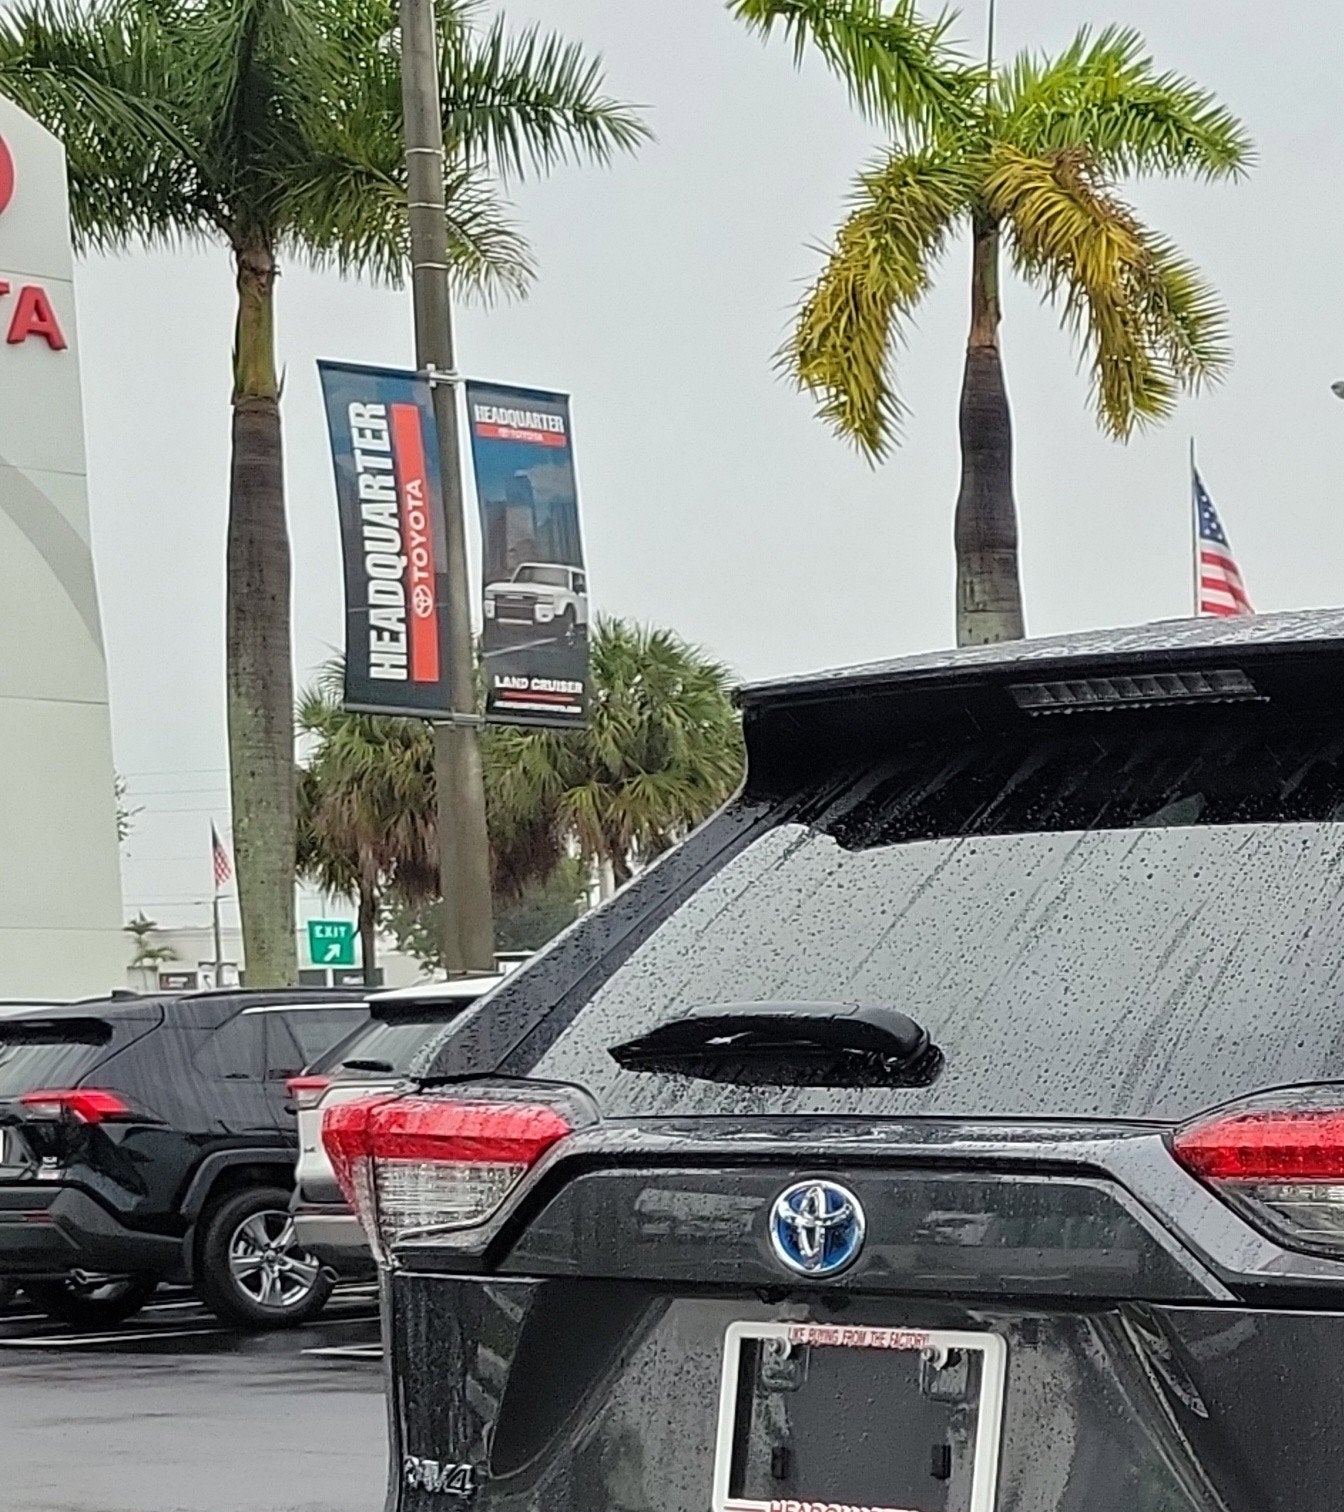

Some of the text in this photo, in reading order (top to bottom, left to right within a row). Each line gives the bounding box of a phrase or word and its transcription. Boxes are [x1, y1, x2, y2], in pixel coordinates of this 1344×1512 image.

[474, 404, 565, 434] HEADQUARTER
[349, 402, 408, 681] HEADQUARTER
[405, 478, 433, 582] TOYOTA
[494, 674, 583, 694] LAND CRUISER
[313, 924, 347, 939] EXIT
[843, 1330, 867, 1344] FROM
[870, 1331, 887, 1345] THE
